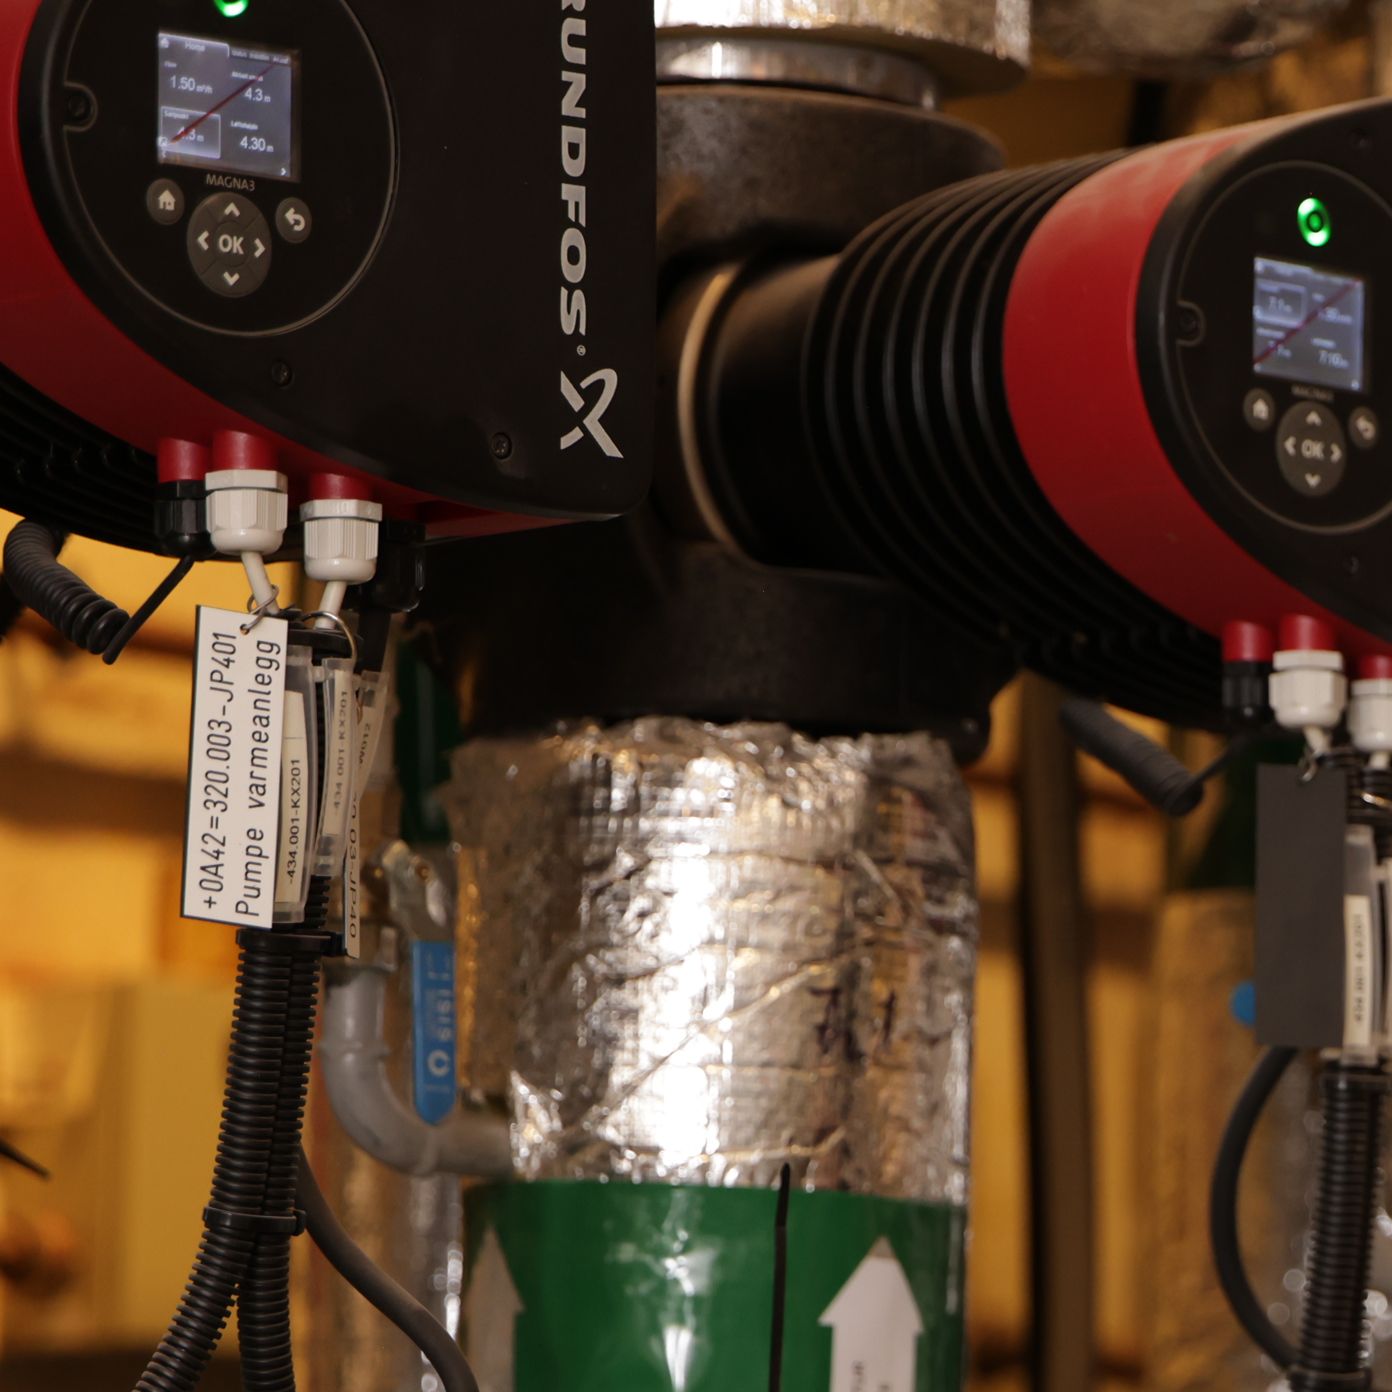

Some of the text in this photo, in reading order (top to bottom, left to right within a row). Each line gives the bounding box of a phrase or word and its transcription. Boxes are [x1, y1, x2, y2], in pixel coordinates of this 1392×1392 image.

[169, 75, 196, 91] 1.50
[244, 87, 264, 102] 4.3
[240, 136, 266, 151] 4.30
[561, 0, 587, 336] UNDFOS
[206, 173, 256, 192] MAGNA3
[218, 234, 244, 255] OK
[1301, 438, 1325, 461] OK
[235, 639, 281, 917] Pumpe varmeanlegg
